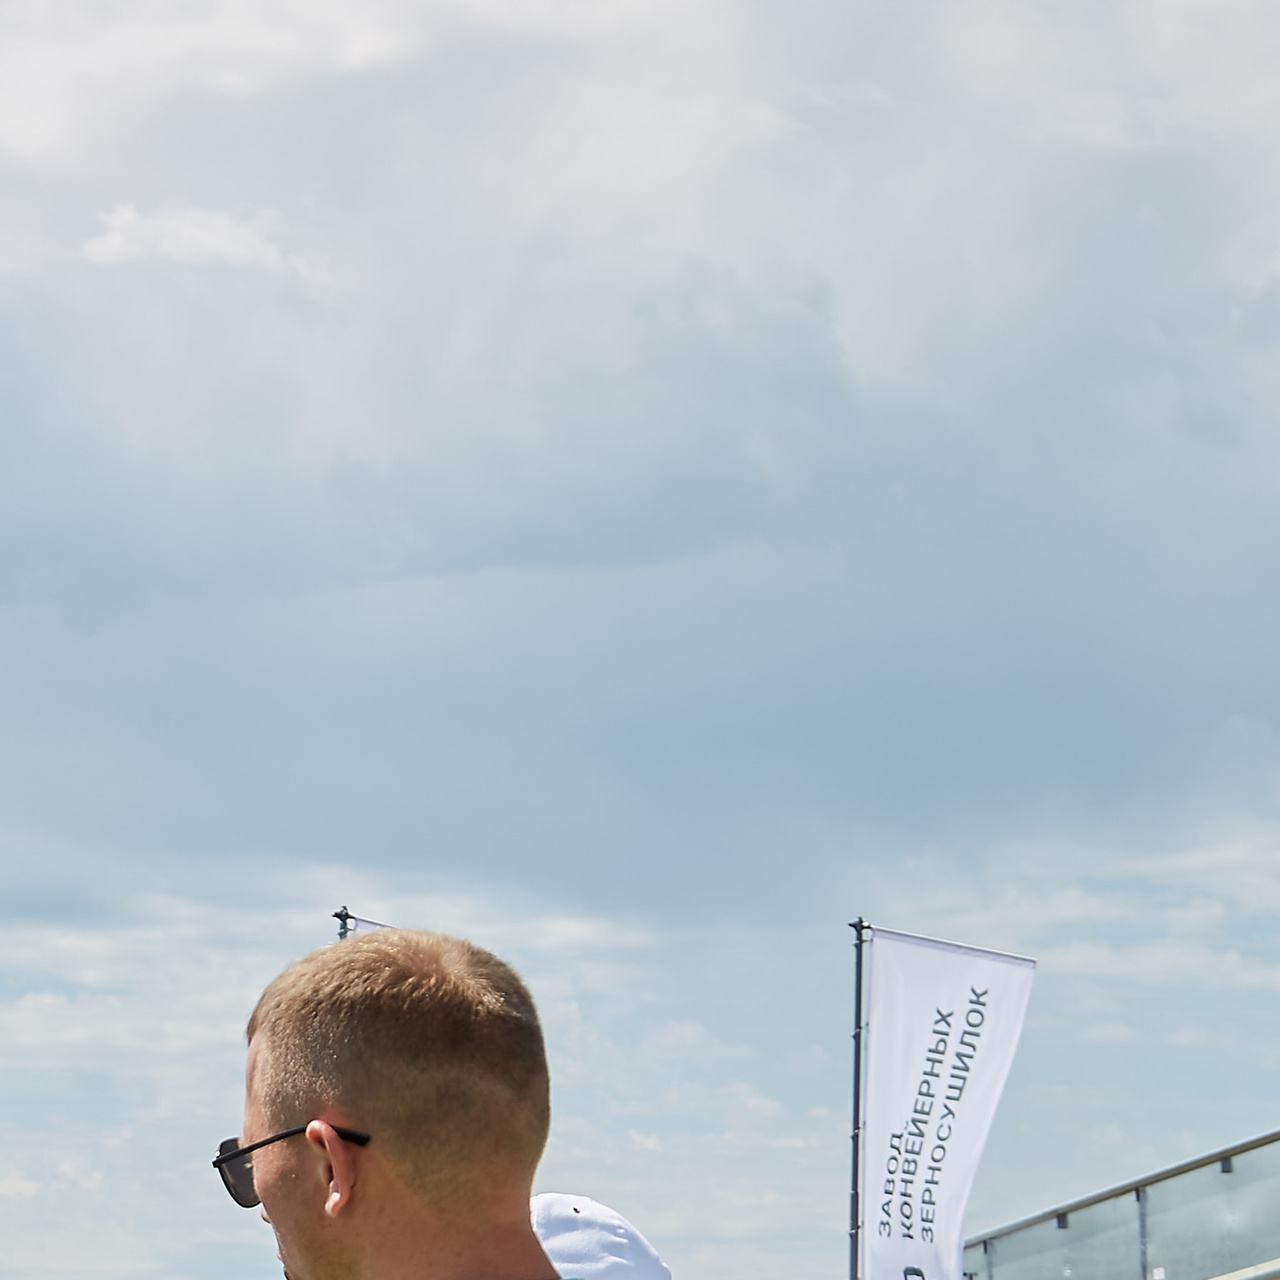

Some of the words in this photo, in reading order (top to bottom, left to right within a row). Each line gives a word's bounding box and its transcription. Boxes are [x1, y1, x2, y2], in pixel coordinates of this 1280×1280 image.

[878, 1131, 904, 1238] ЗАВОД
[900, 1007, 955, 1240] КОНВЕЙЕРНЫХ
[921, 985, 989, 1243] ЗЕРНОСУШИЛОК
